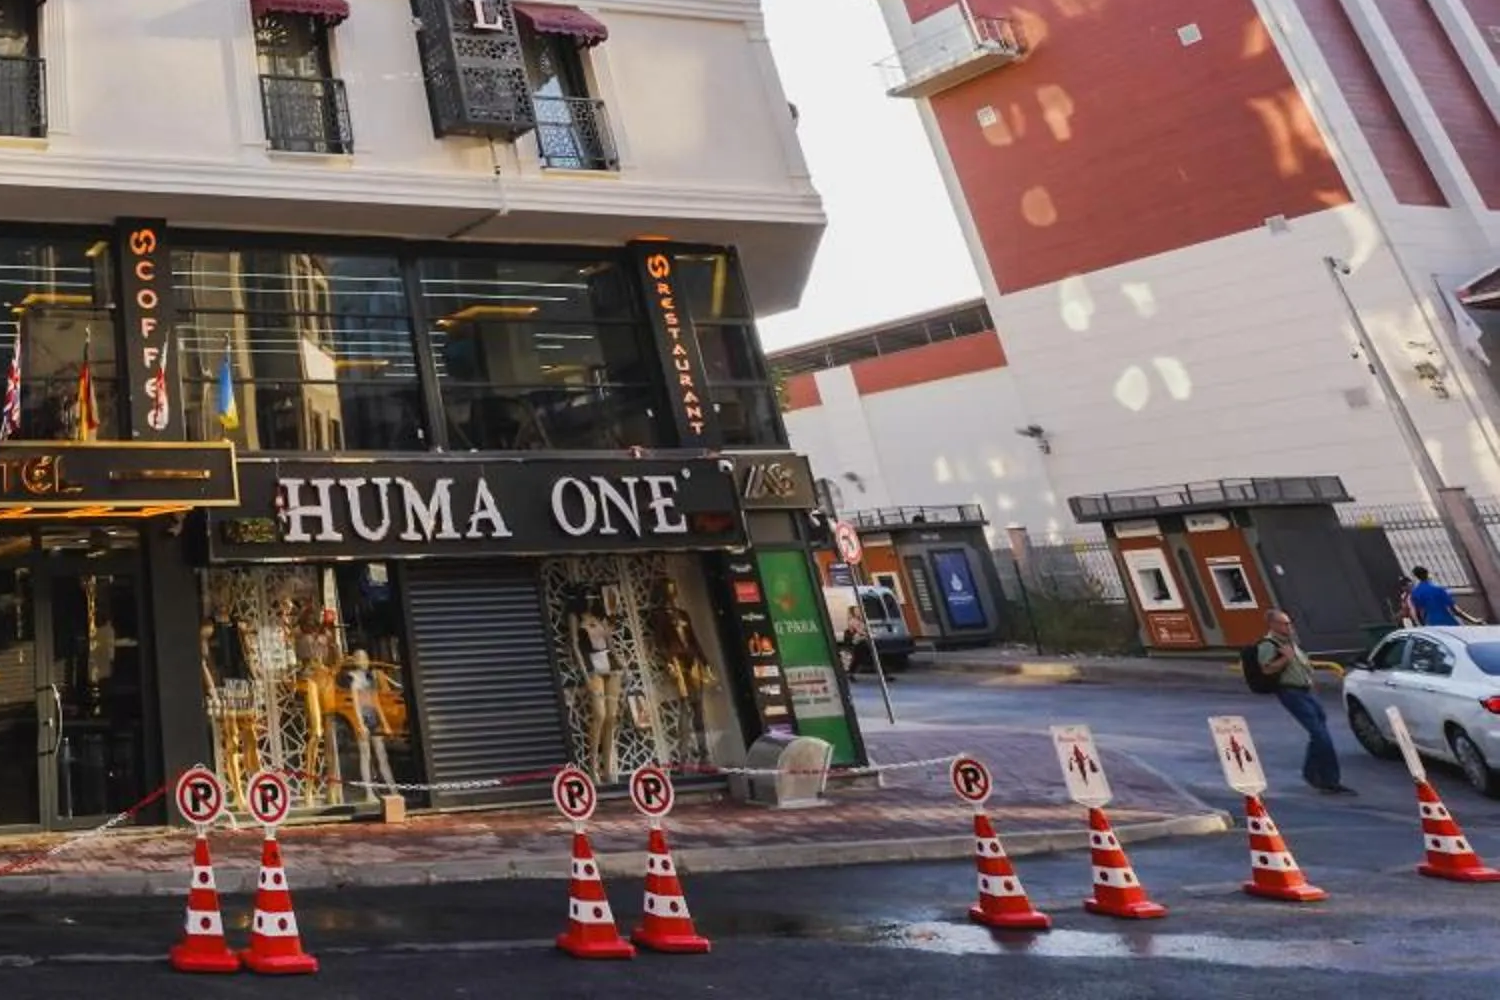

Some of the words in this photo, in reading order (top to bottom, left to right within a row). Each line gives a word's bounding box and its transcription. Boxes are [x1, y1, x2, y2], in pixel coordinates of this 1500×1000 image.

[655, 283, 705, 436] RESTAURANT
[278, 476, 514, 543] HUMA
[551, 474, 688, 538] ONE
